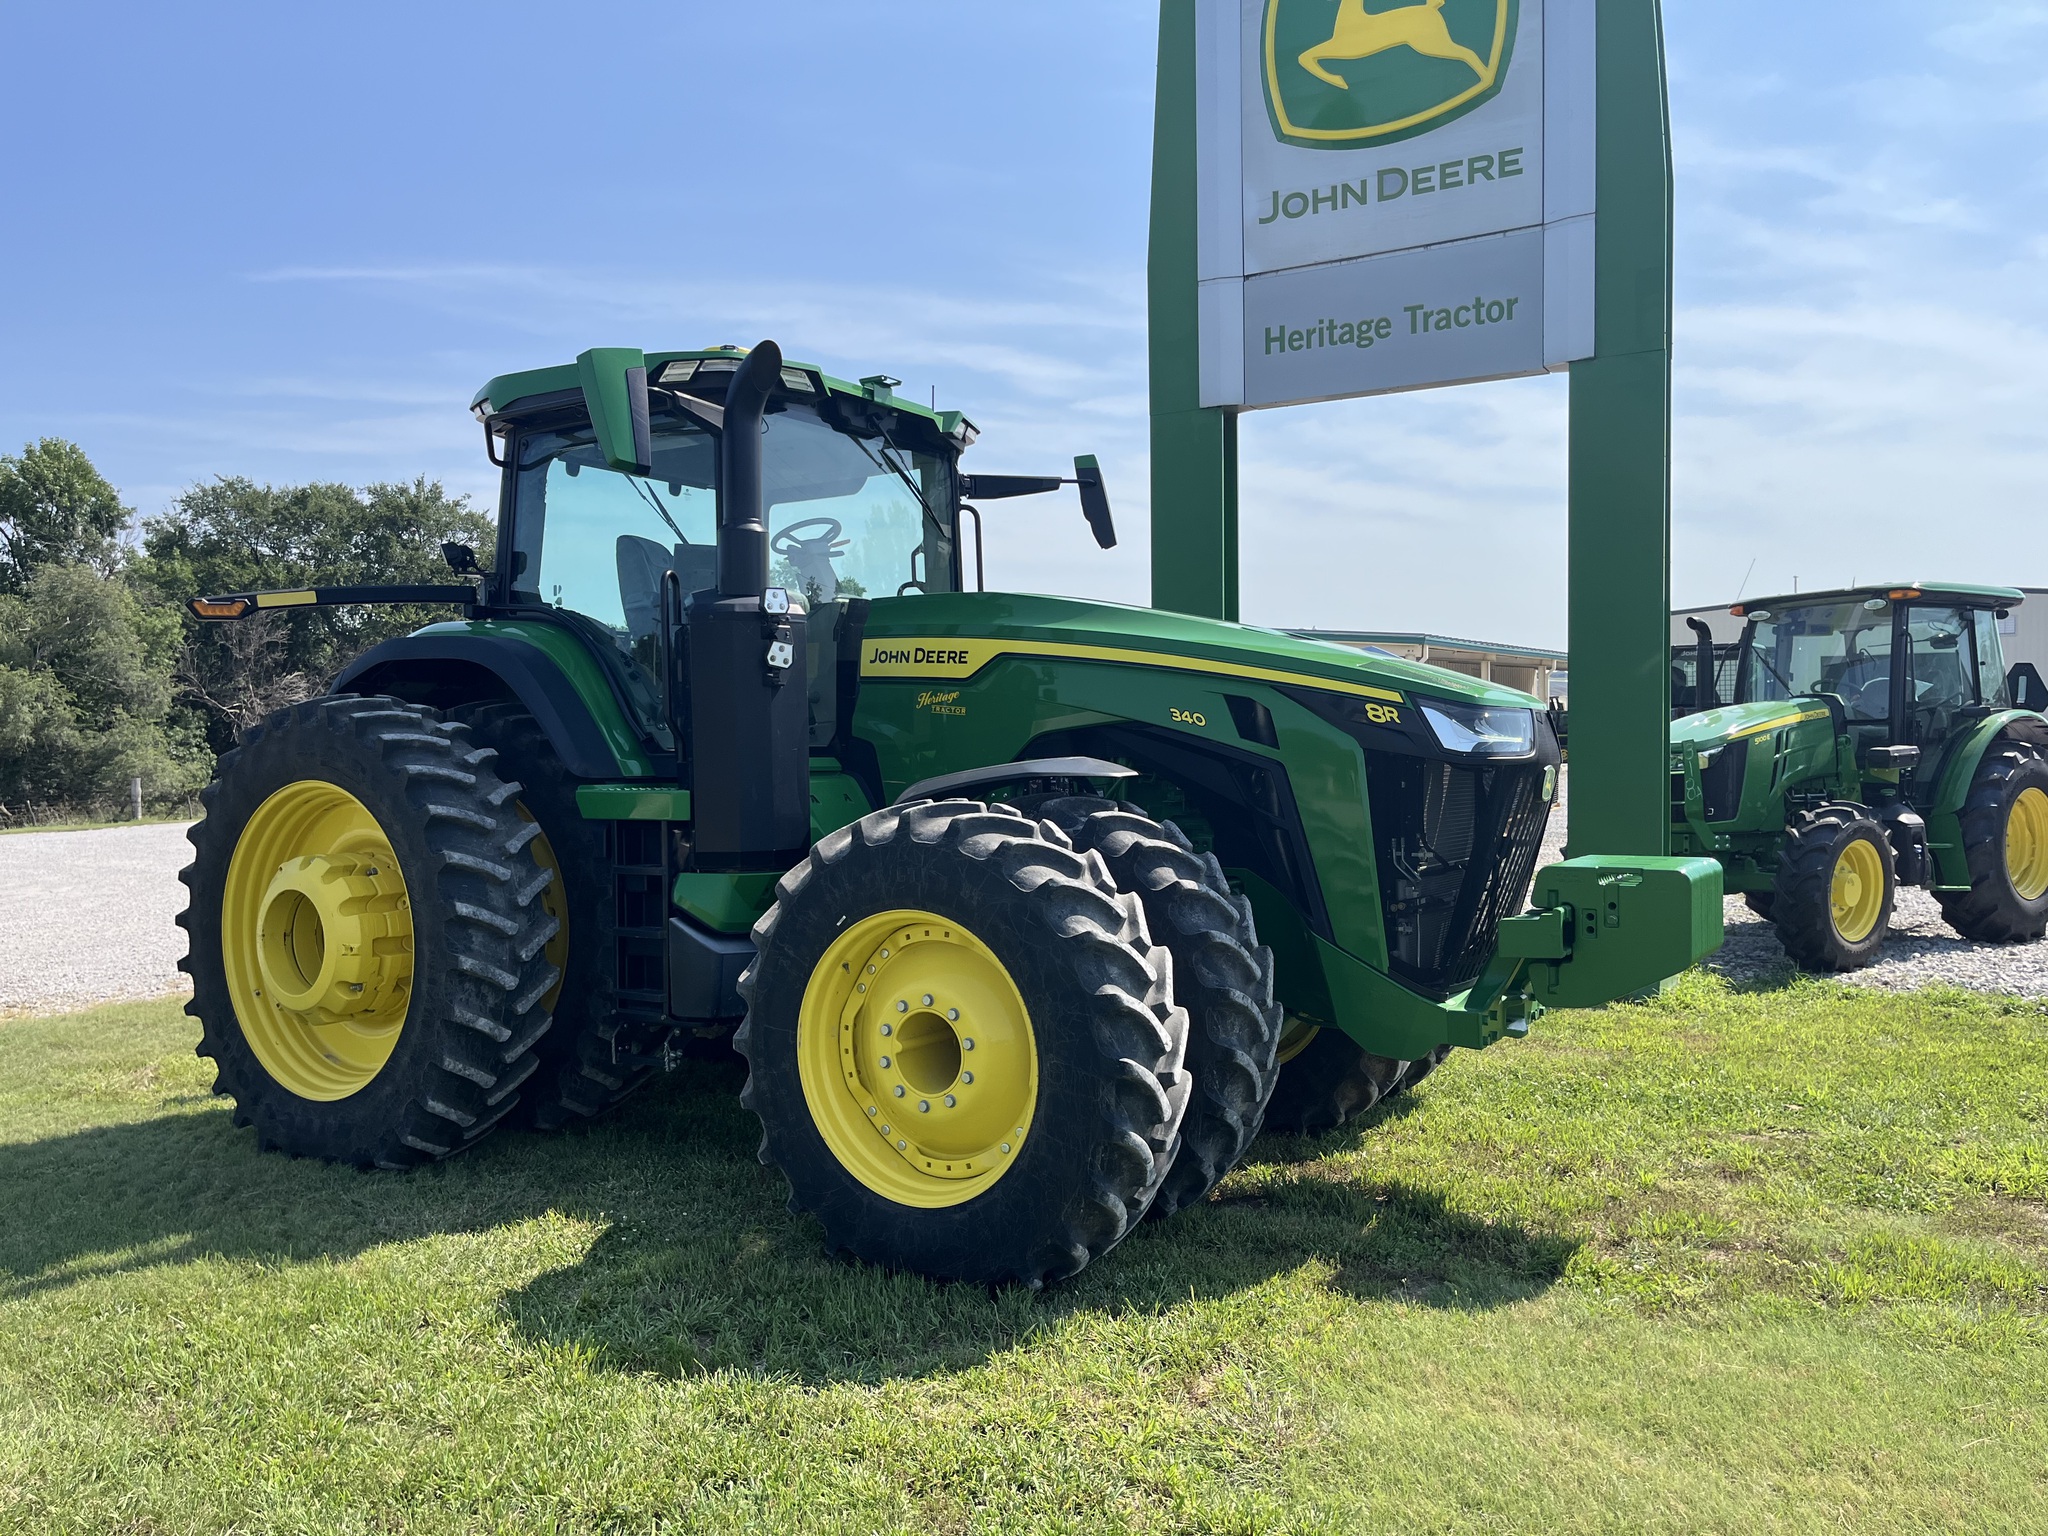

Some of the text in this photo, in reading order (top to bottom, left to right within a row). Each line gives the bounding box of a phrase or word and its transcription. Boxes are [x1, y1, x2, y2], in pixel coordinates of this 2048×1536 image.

[1259, 147, 1523, 224] JOHN DEERE
[1264, 296, 1519, 355] Heritage Tractor
[869, 647, 969, 664] JOHN DEERE
[915, 690, 960, 709] Heritage
[931, 705, 967, 715] TRACTOR
[1169, 707, 1207, 727] 340
[1364, 703, 1402, 724] 8R
